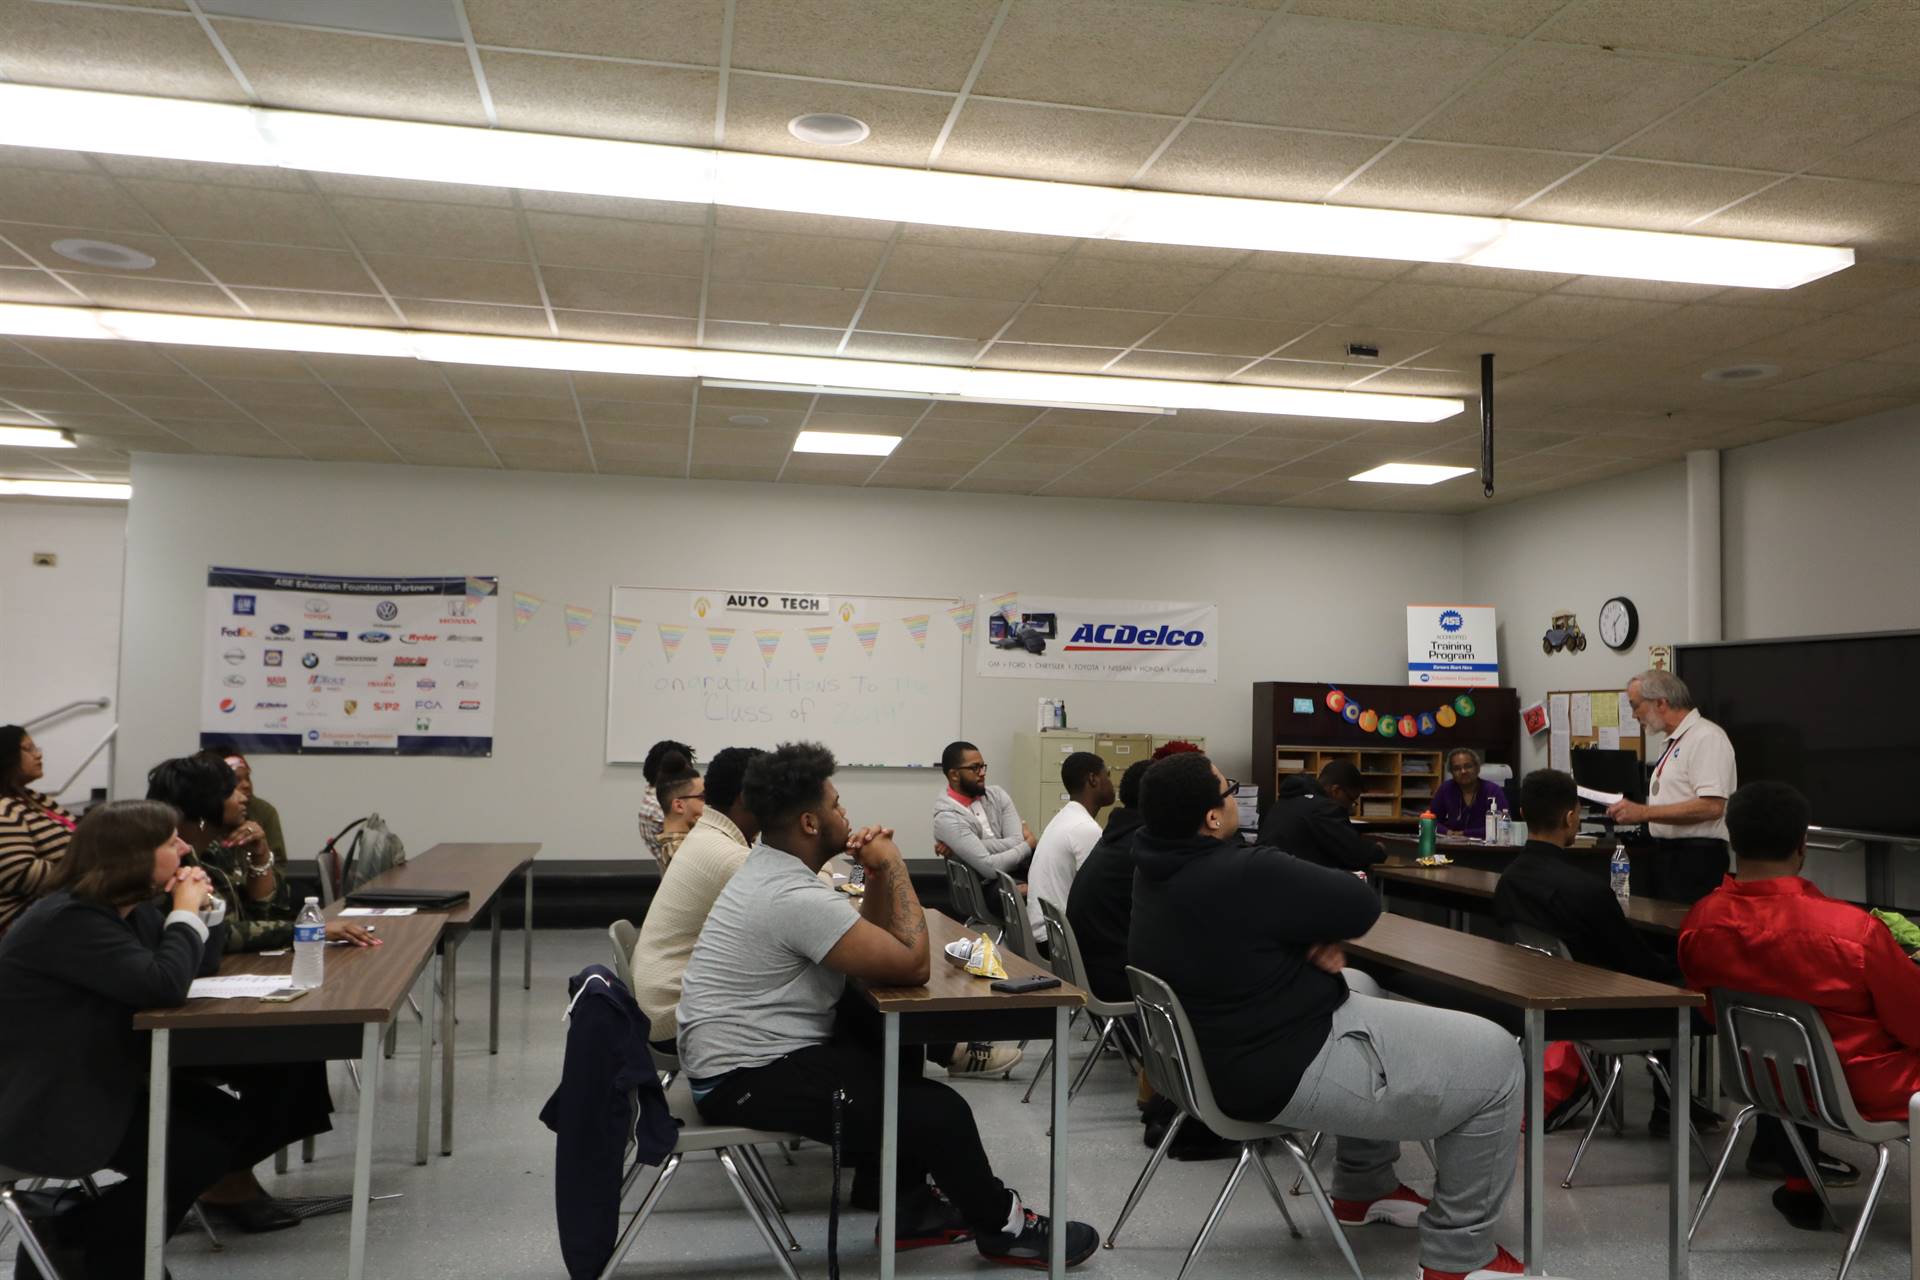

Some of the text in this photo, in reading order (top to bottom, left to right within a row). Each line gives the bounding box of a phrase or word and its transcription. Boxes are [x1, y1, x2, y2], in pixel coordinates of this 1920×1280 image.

[275, 578, 294, 587] ASE
[296, 580, 341, 590] Education
[343, 583, 393, 592] Foundation
[727, 594, 820, 610] AUTO TECH
[1441, 616, 1461, 626] ASE
[221, 627, 254, 638] FedEx
[1070, 623, 1204, 646] ACDelco
[1430, 641, 1472, 653] Training
[1428, 650, 1475, 662] Program
[1074, 663, 1100, 671] TOYOTA
[1140, 665, 1166, 673] HONDA
[415, 701, 442, 710] FCA
[704, 692, 773, 722] Class
[790, 697, 815, 725] of
